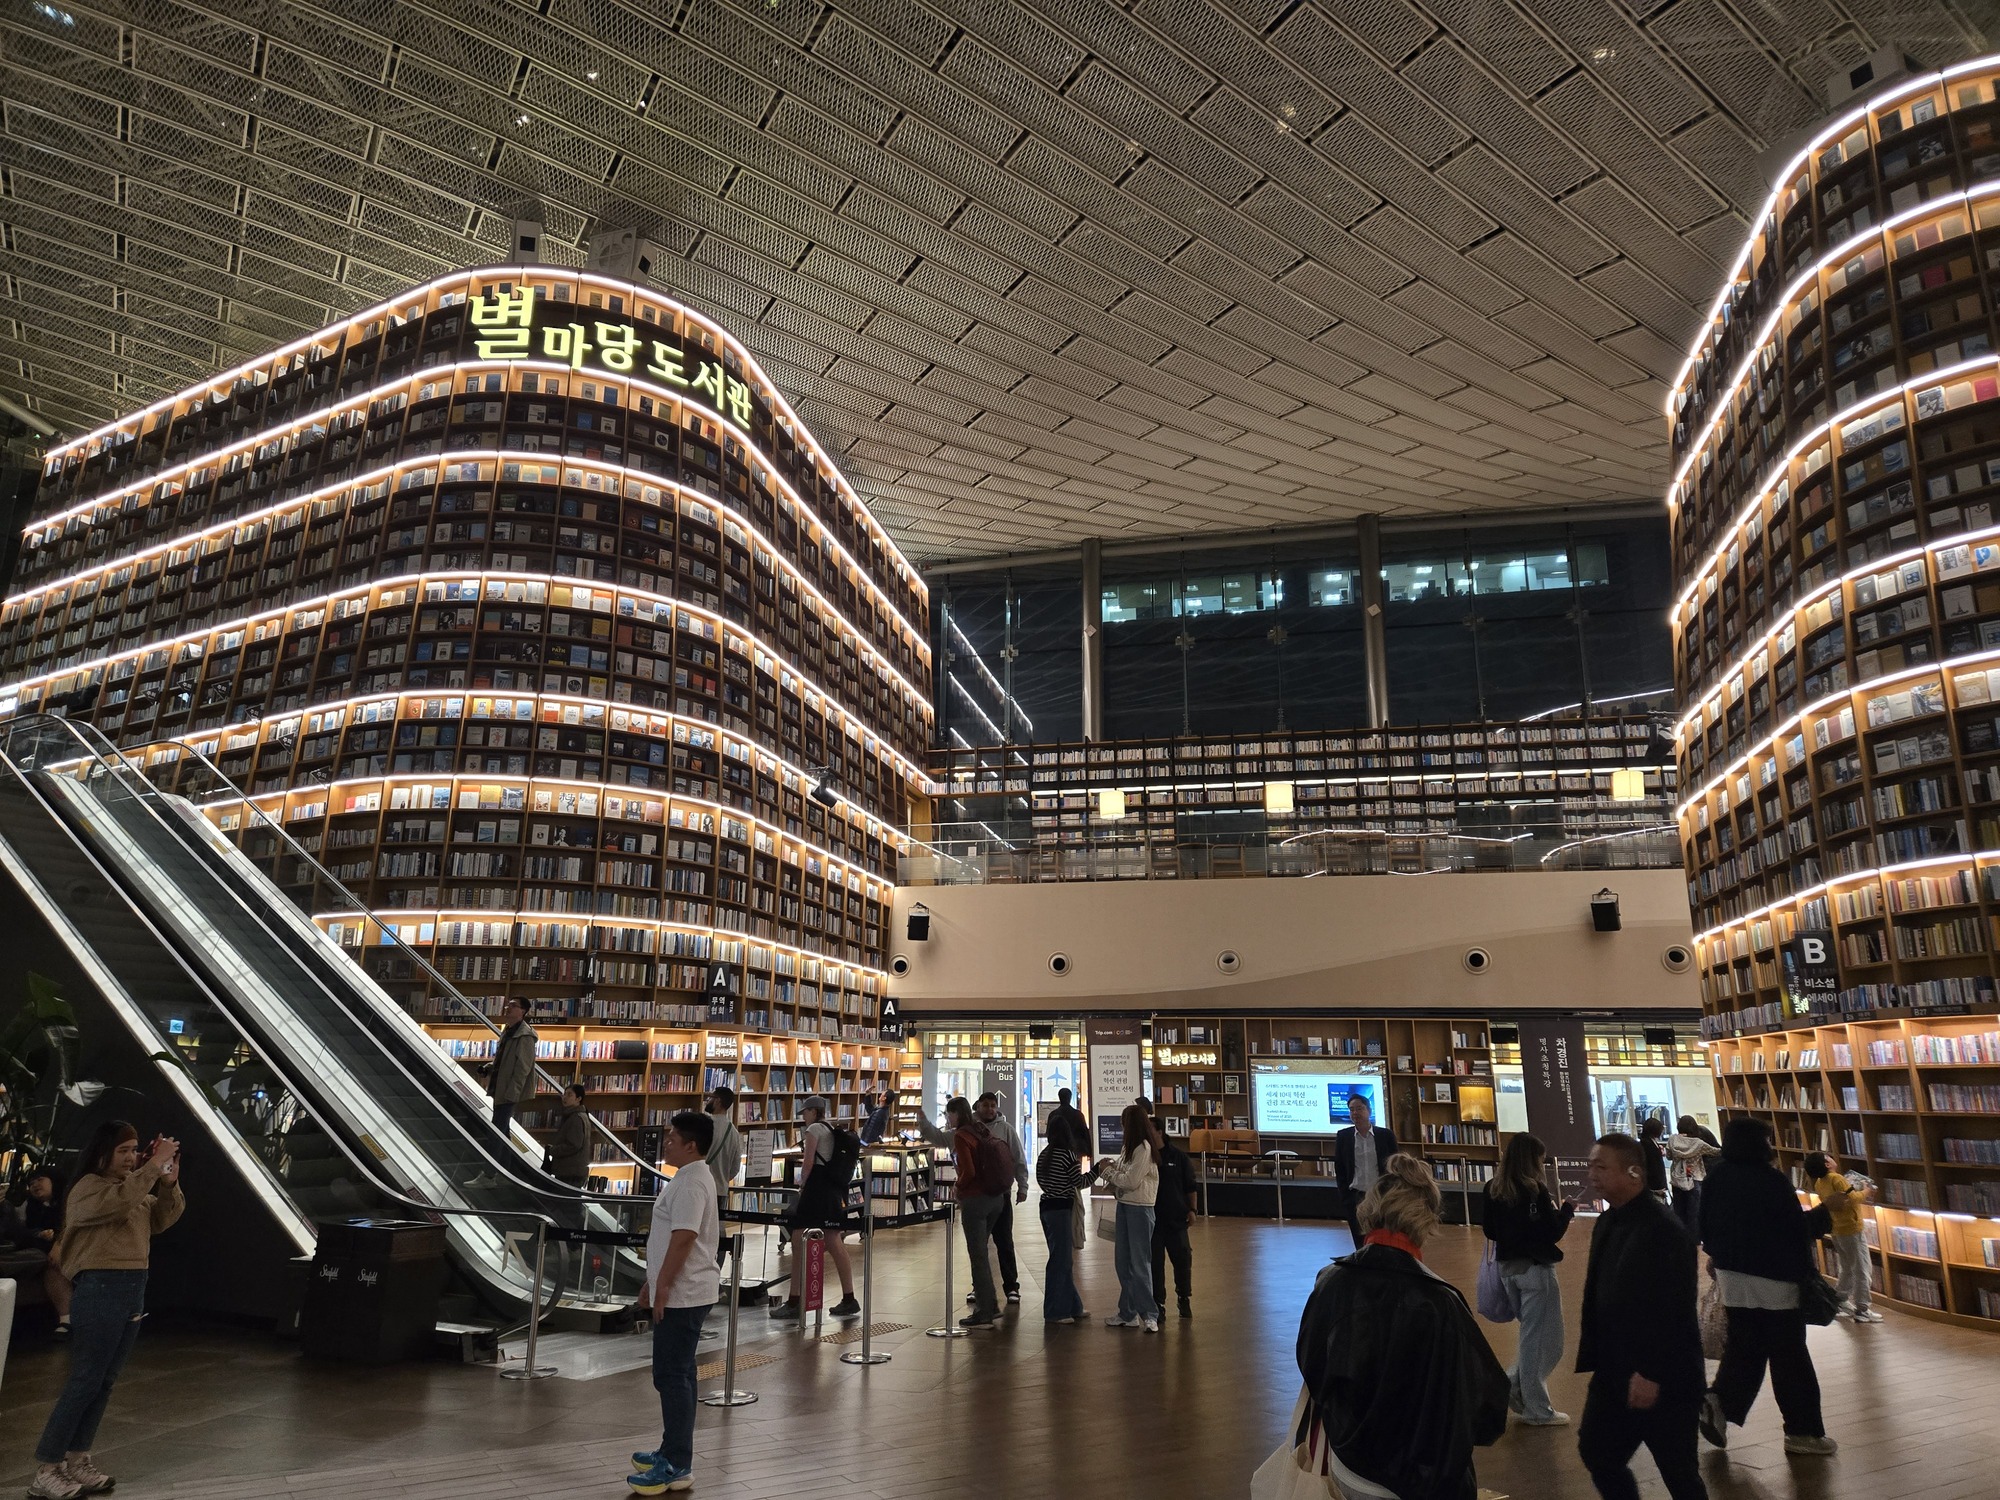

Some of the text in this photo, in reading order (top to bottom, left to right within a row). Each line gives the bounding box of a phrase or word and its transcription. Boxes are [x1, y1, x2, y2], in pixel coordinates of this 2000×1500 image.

[1802, 938, 1826, 964] B
[587, 957, 594, 978] A
[713, 967, 726, 987] A
[1804, 978, 1836, 989] 비소설
[711, 996, 726, 1005] 무역
[1806, 992, 1838, 1004] 에세이
[883, 1000, 896, 1015] A
[881, 1024, 897, 1033] 소설
[1555, 1037, 1569, 1069] 차경진
[985, 1063, 1014, 1073] Airport
[998, 1073, 1014, 1081] Bus
